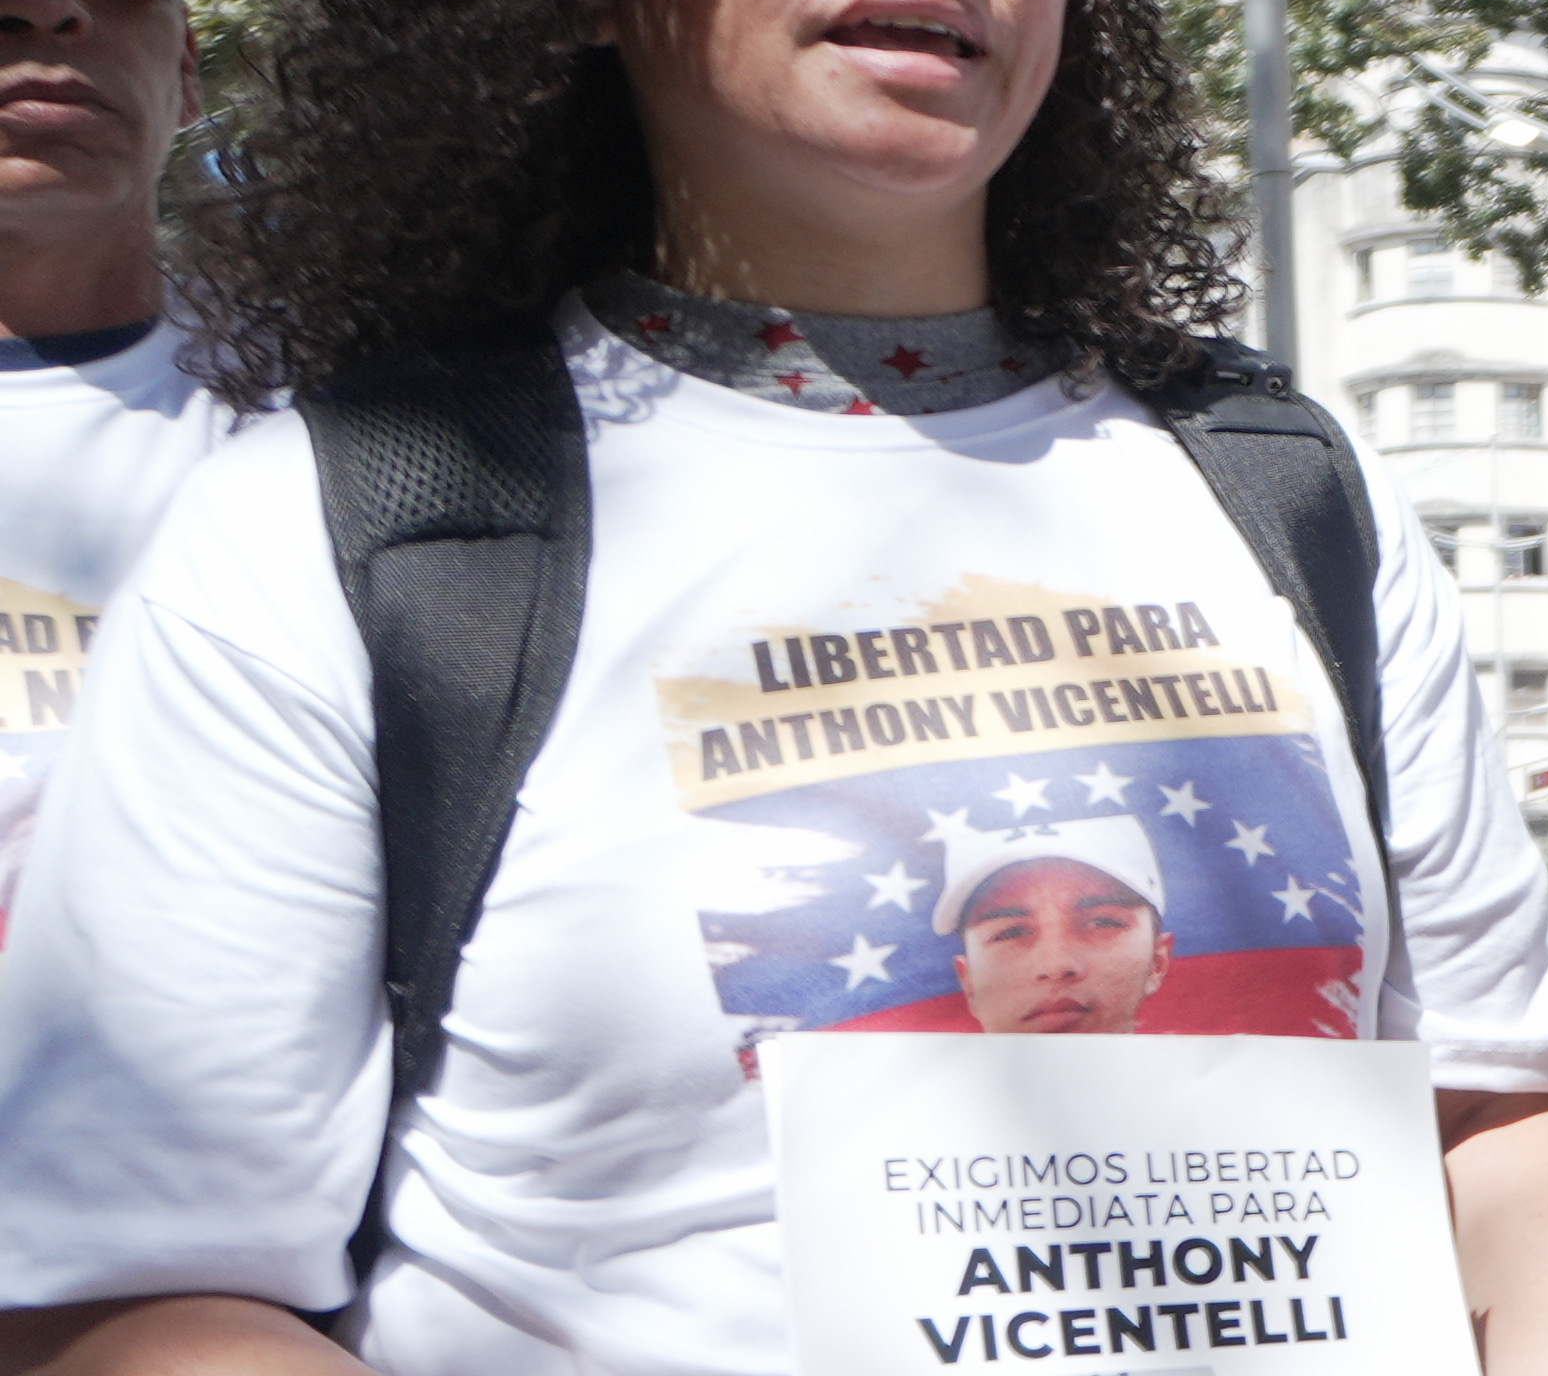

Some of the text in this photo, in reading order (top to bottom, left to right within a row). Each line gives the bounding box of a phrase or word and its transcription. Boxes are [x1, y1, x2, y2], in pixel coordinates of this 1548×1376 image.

[752, 602, 1219, 692] LIBERTAD PARA
[702, 666, 1278, 782] ANTHONY VICENTELLI
[884, 1148, 1361, 1191] EXIGIMOS LIBERTAD
[916, 1190, 1332, 1234] INMEDIATA PARA
[956, 1235, 1321, 1297] ANTHONY
[915, 1296, 1348, 1365] VICENTELLI
